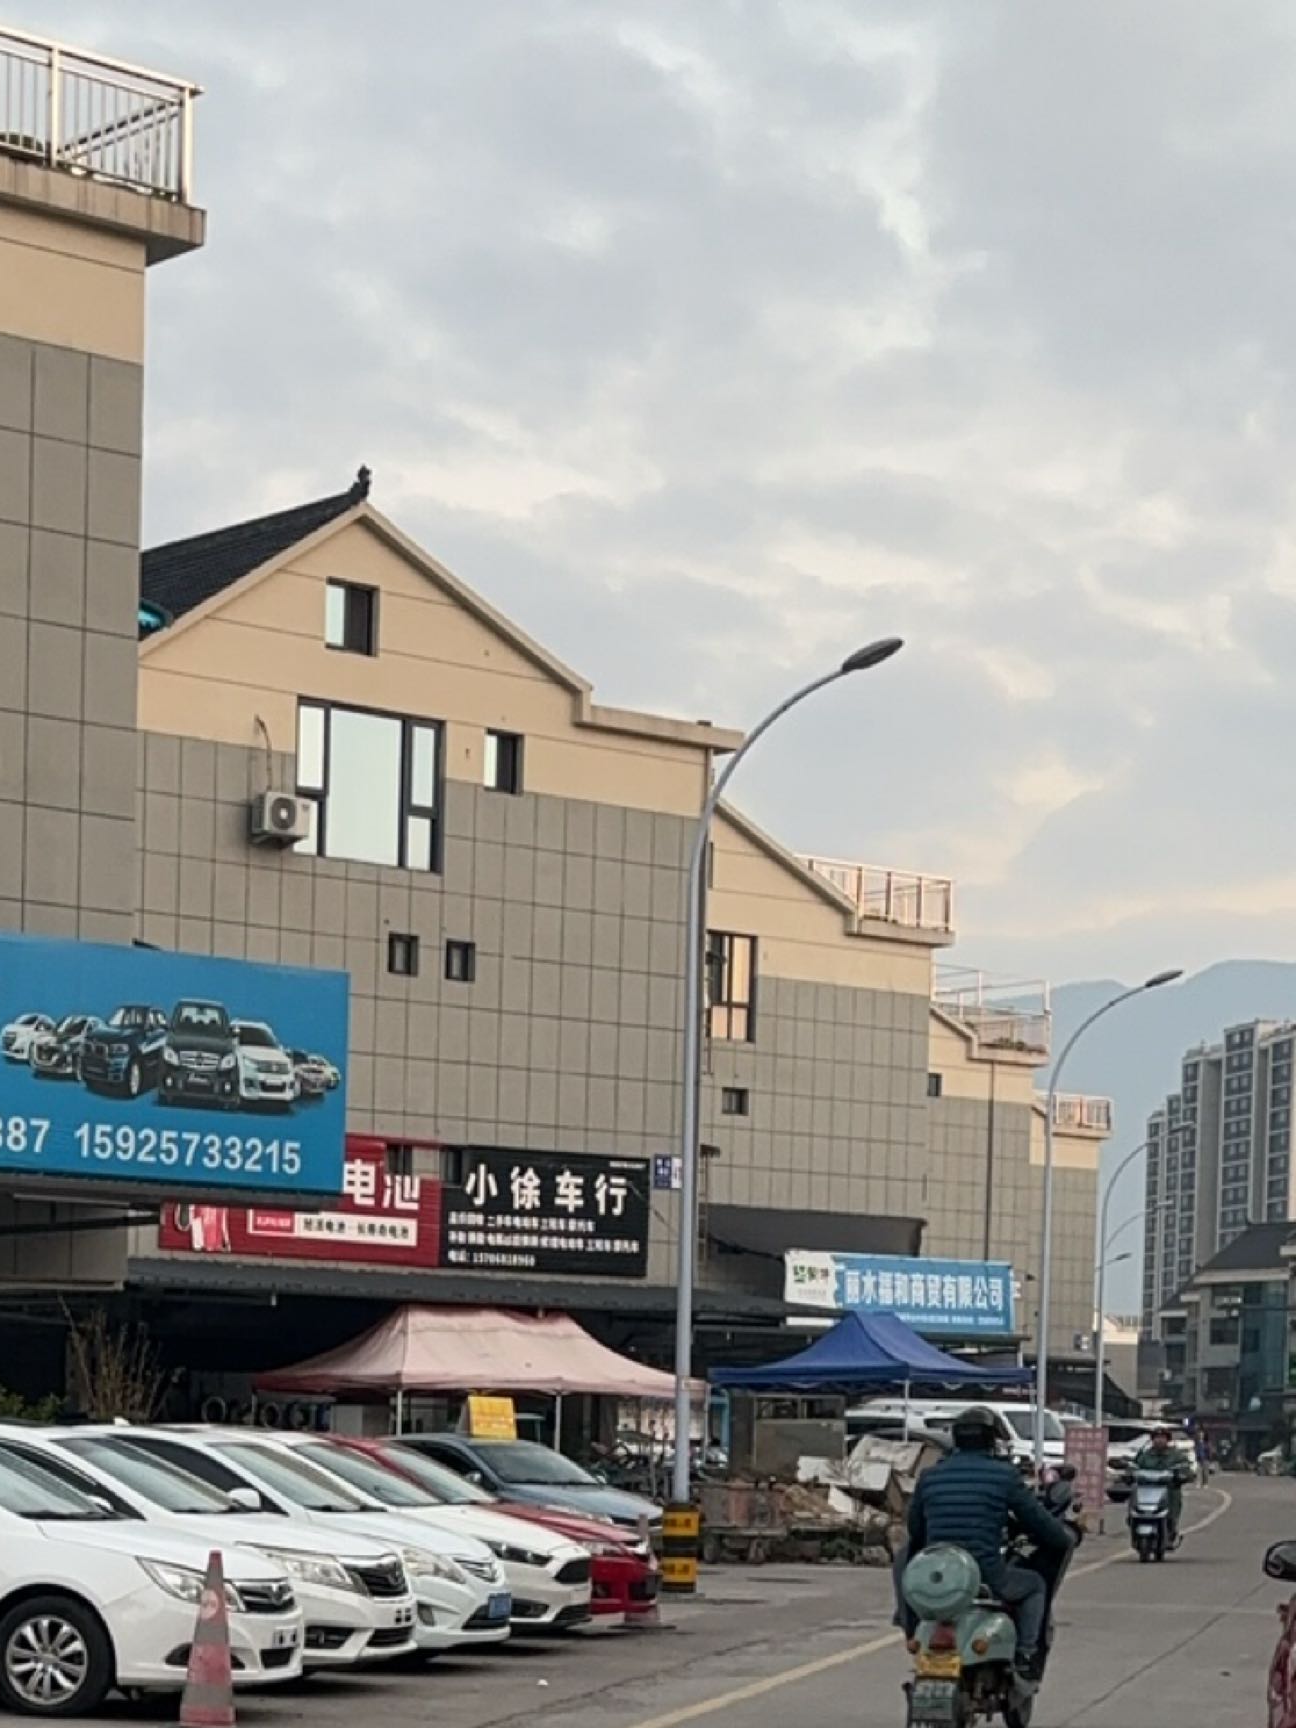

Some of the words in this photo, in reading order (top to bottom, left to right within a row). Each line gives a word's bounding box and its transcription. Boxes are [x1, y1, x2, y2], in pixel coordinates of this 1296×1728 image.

[74, 1123, 302, 1176] 15925733215
[466, 1163, 628, 1217] 小徐车行
